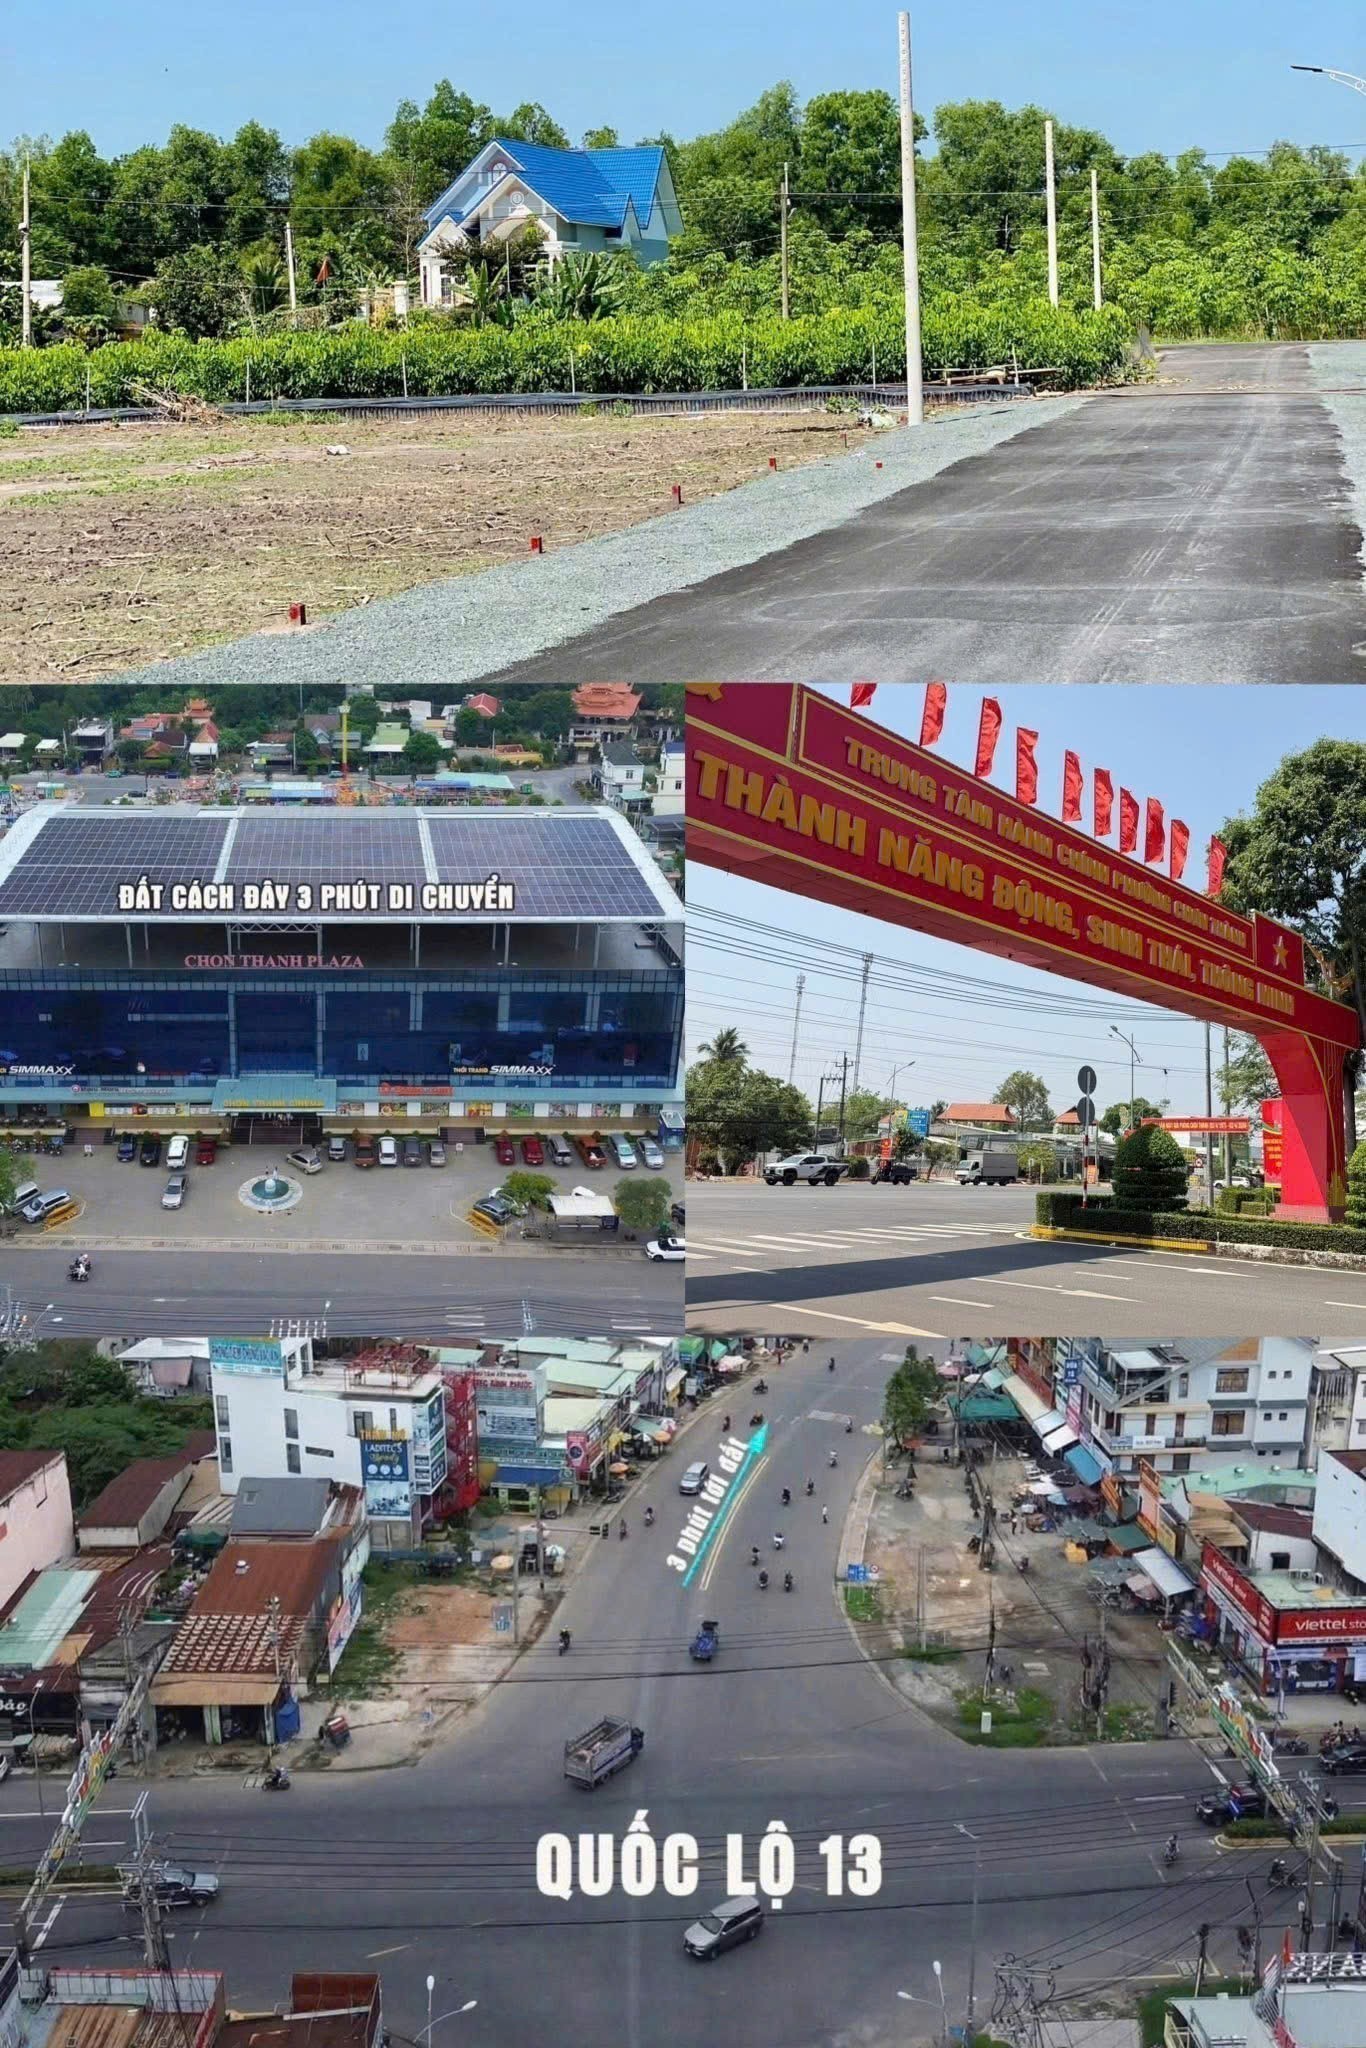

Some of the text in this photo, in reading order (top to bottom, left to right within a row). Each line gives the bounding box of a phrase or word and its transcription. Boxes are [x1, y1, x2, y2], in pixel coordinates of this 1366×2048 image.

[844, 735, 937, 804] TRUNG
[943, 785, 992, 829] TÂM
[997, 814, 1054, 860] HÀNH
[1057, 844, 1110, 886] CHÍNH
[1113, 869, 1171, 914] PHƯỜNG
[693, 750, 868, 857] THÀNH
[878, 826, 985, 902] NĂNG
[992, 874, 1080, 940] ĐỘNG,
[1086, 914, 1143, 960] SINH
[1200, 958, 1254, 1001] THÔNG
[1257, 981, 1295, 1016] MINH
[239, 954, 303, 968] THANH
[307, 954, 365, 968] PLAZA
[1295, 1618, 1347, 1631] viettel
